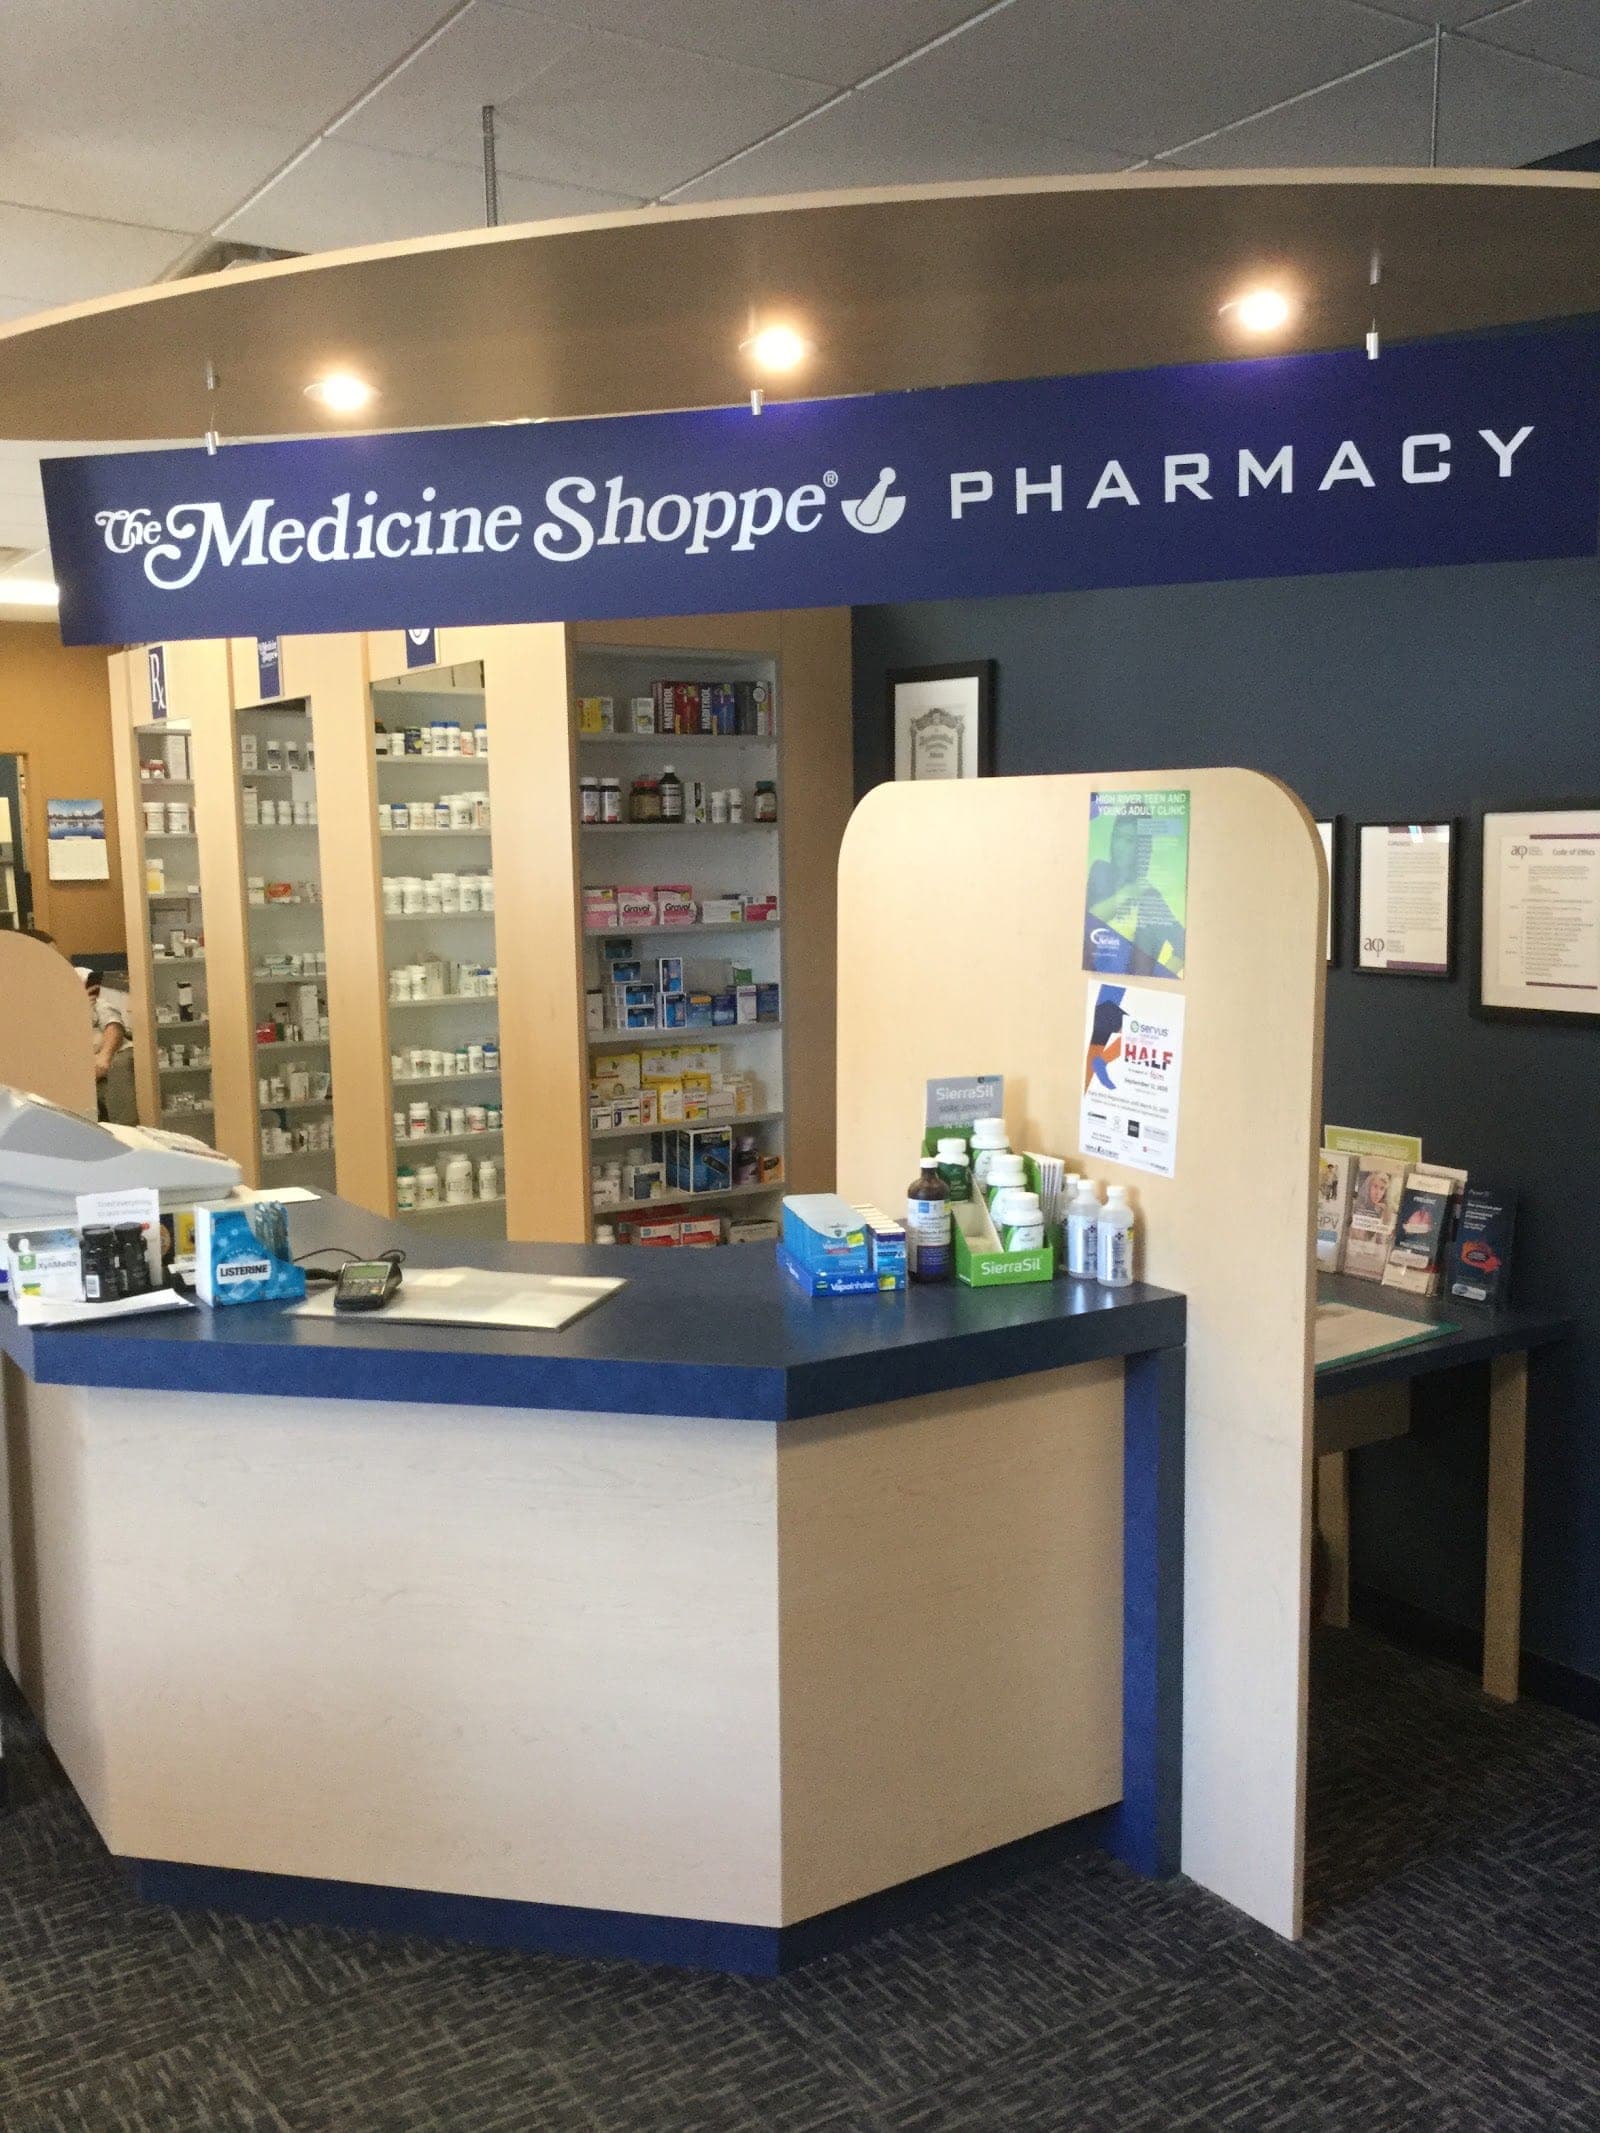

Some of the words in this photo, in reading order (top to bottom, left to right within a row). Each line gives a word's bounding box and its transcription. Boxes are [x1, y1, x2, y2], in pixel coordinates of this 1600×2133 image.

[95, 508, 162, 553] The
[143, 486, 522, 590] Medicine
[949, 425, 1535, 519] PHARMACY
[1168, 793, 1186, 803] AND
[1097, 805, 1127, 816] YOUNG
[1128, 805, 1157, 816] ADULT
[1157, 805, 1186, 816] CLINIC
[623, 903, 651, 913] Gravol
[664, 902, 691, 912] Gravol
[1124, 1043, 1174, 1071] HALF
[935, 1084, 994, 1101] SierraSil
[220, 1264, 268, 1277] LISTERINE
[981, 1257, 1041, 1276] SierraSil
